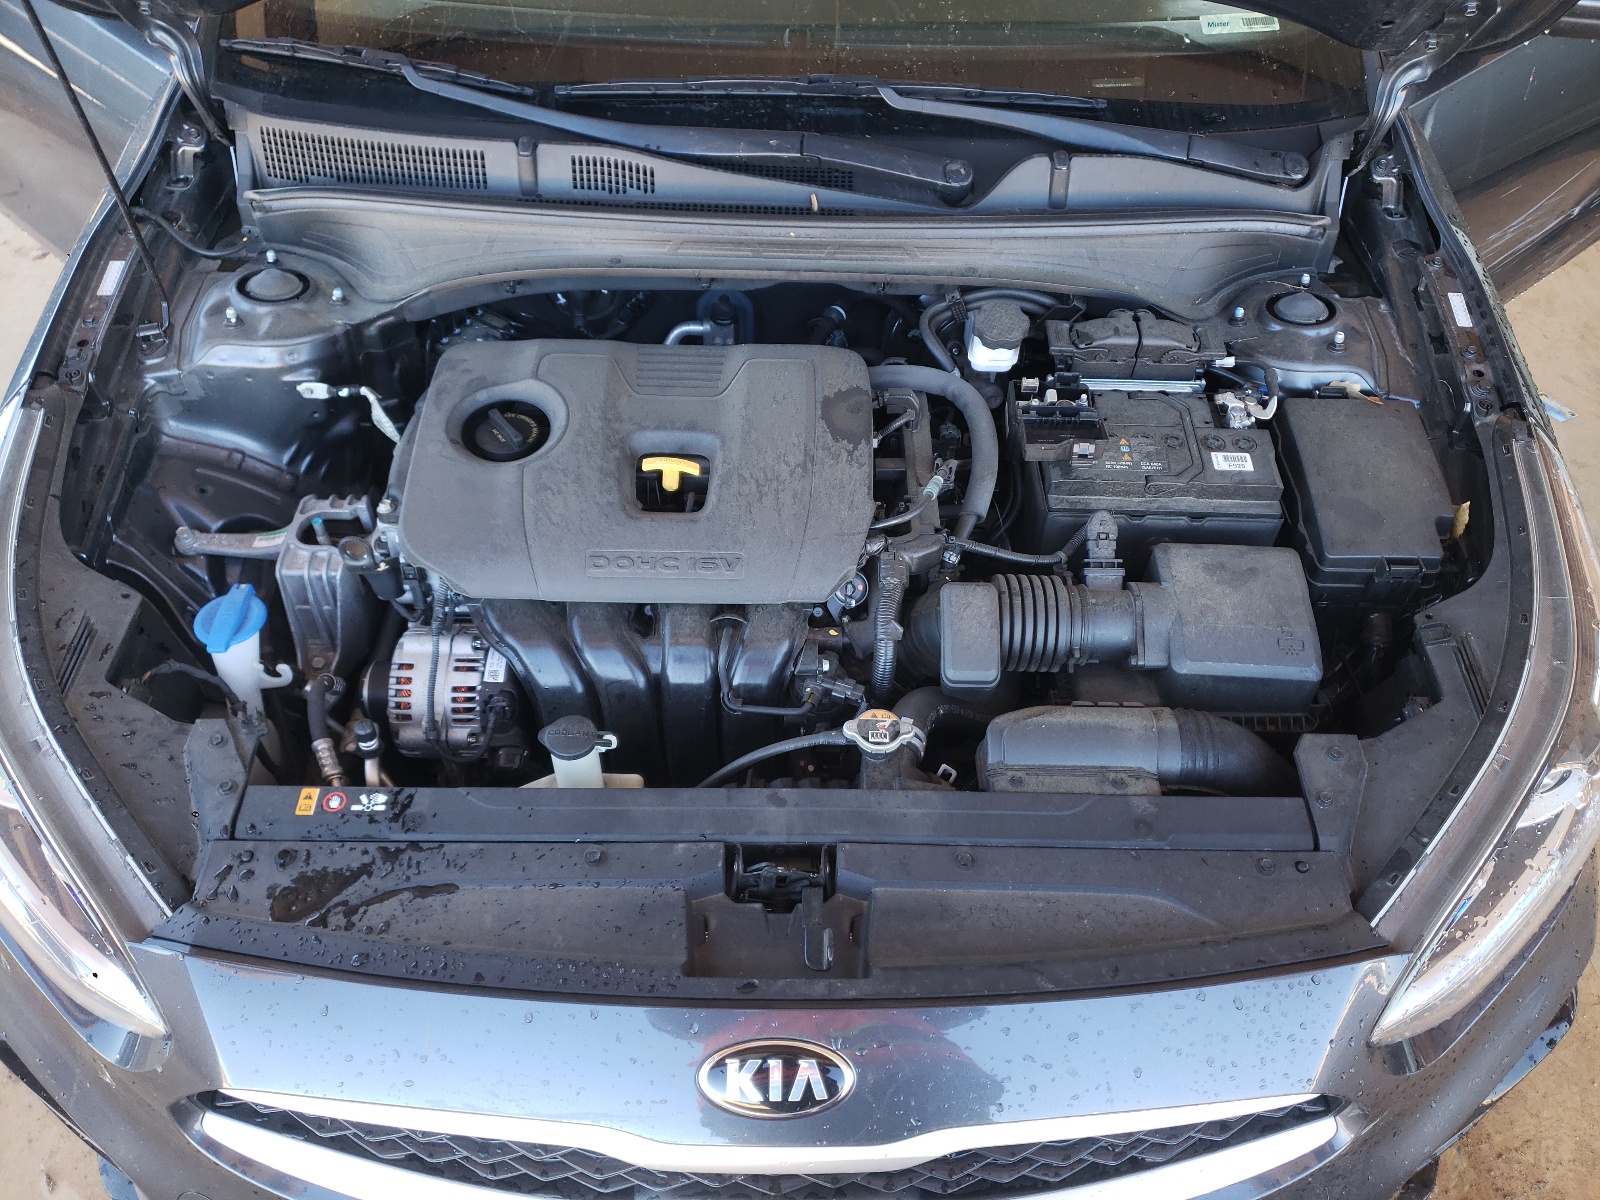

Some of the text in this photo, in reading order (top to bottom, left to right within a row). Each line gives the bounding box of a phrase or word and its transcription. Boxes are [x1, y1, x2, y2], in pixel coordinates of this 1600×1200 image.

[588, 555, 680, 572] DOHC
[547, 729, 597, 739] COOLANT
[725, 1059, 828, 1104] KIA
